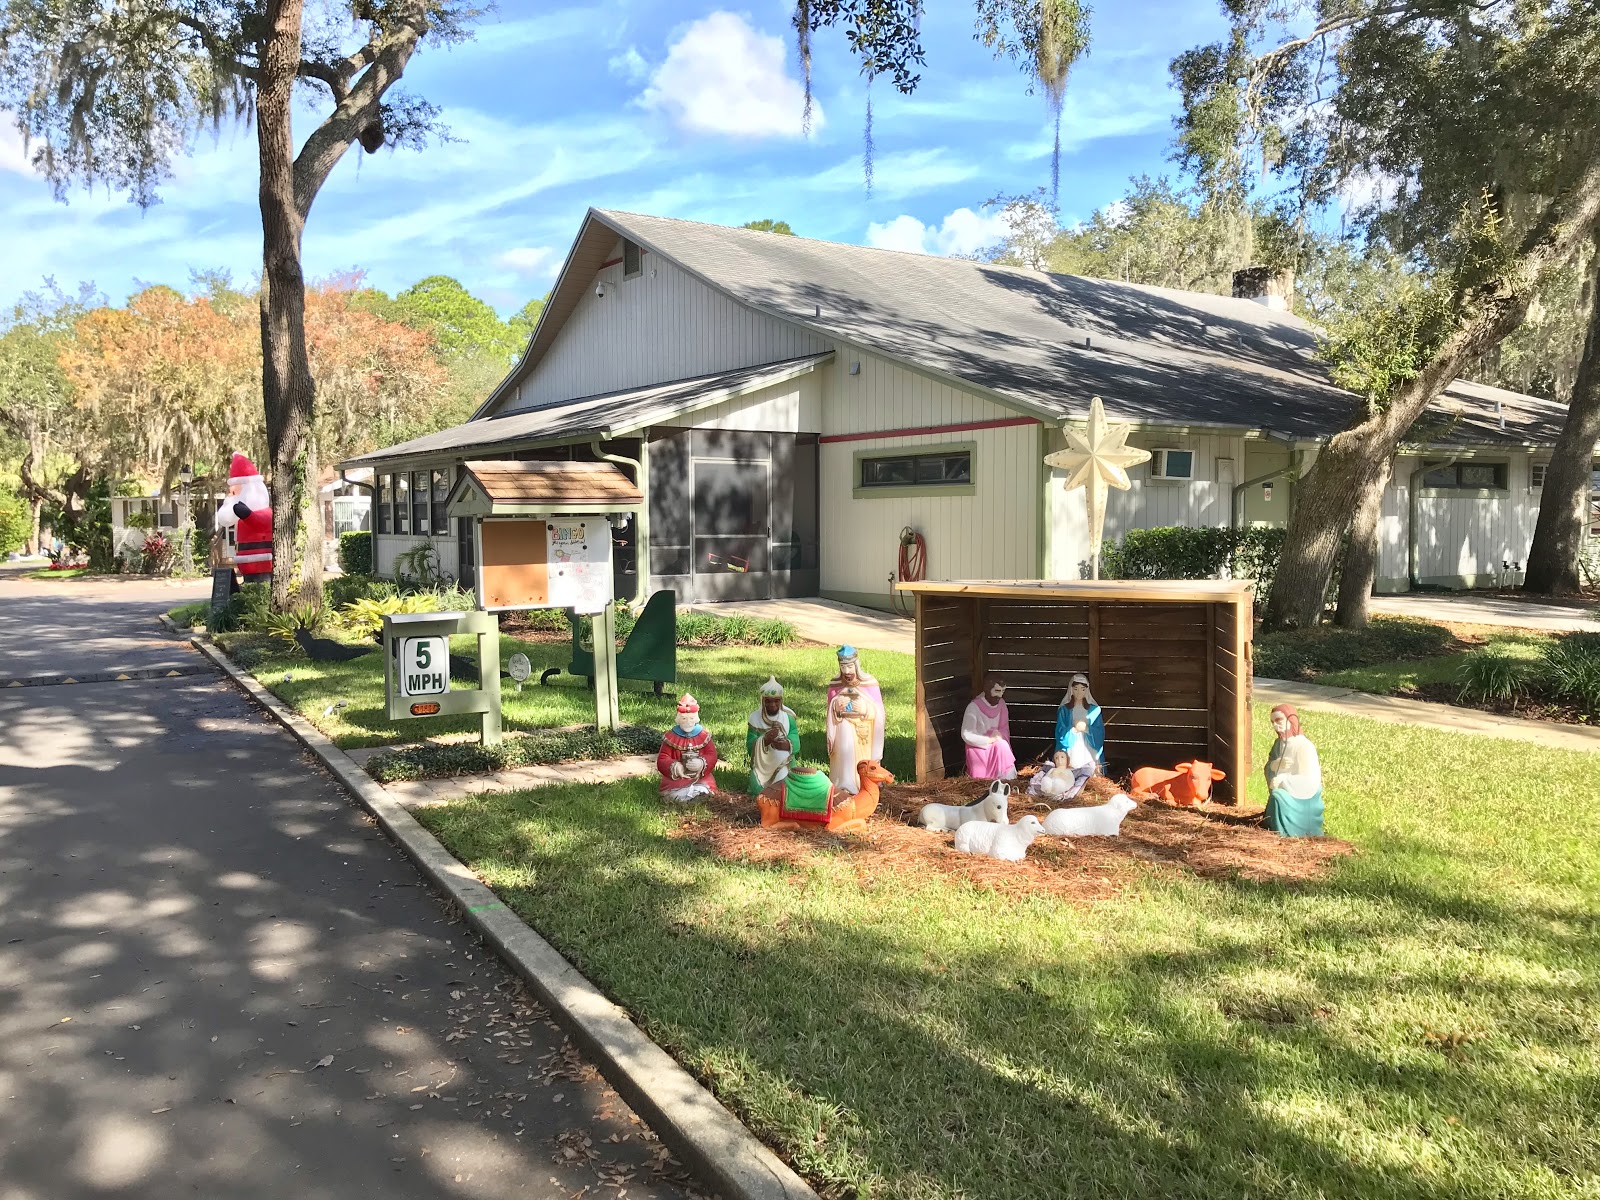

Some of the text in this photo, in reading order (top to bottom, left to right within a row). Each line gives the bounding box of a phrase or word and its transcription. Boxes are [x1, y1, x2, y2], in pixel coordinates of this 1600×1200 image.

[552, 528, 585, 541] BINGO
[416, 641, 432, 669] 5
[408, 673, 443, 691] MPH
